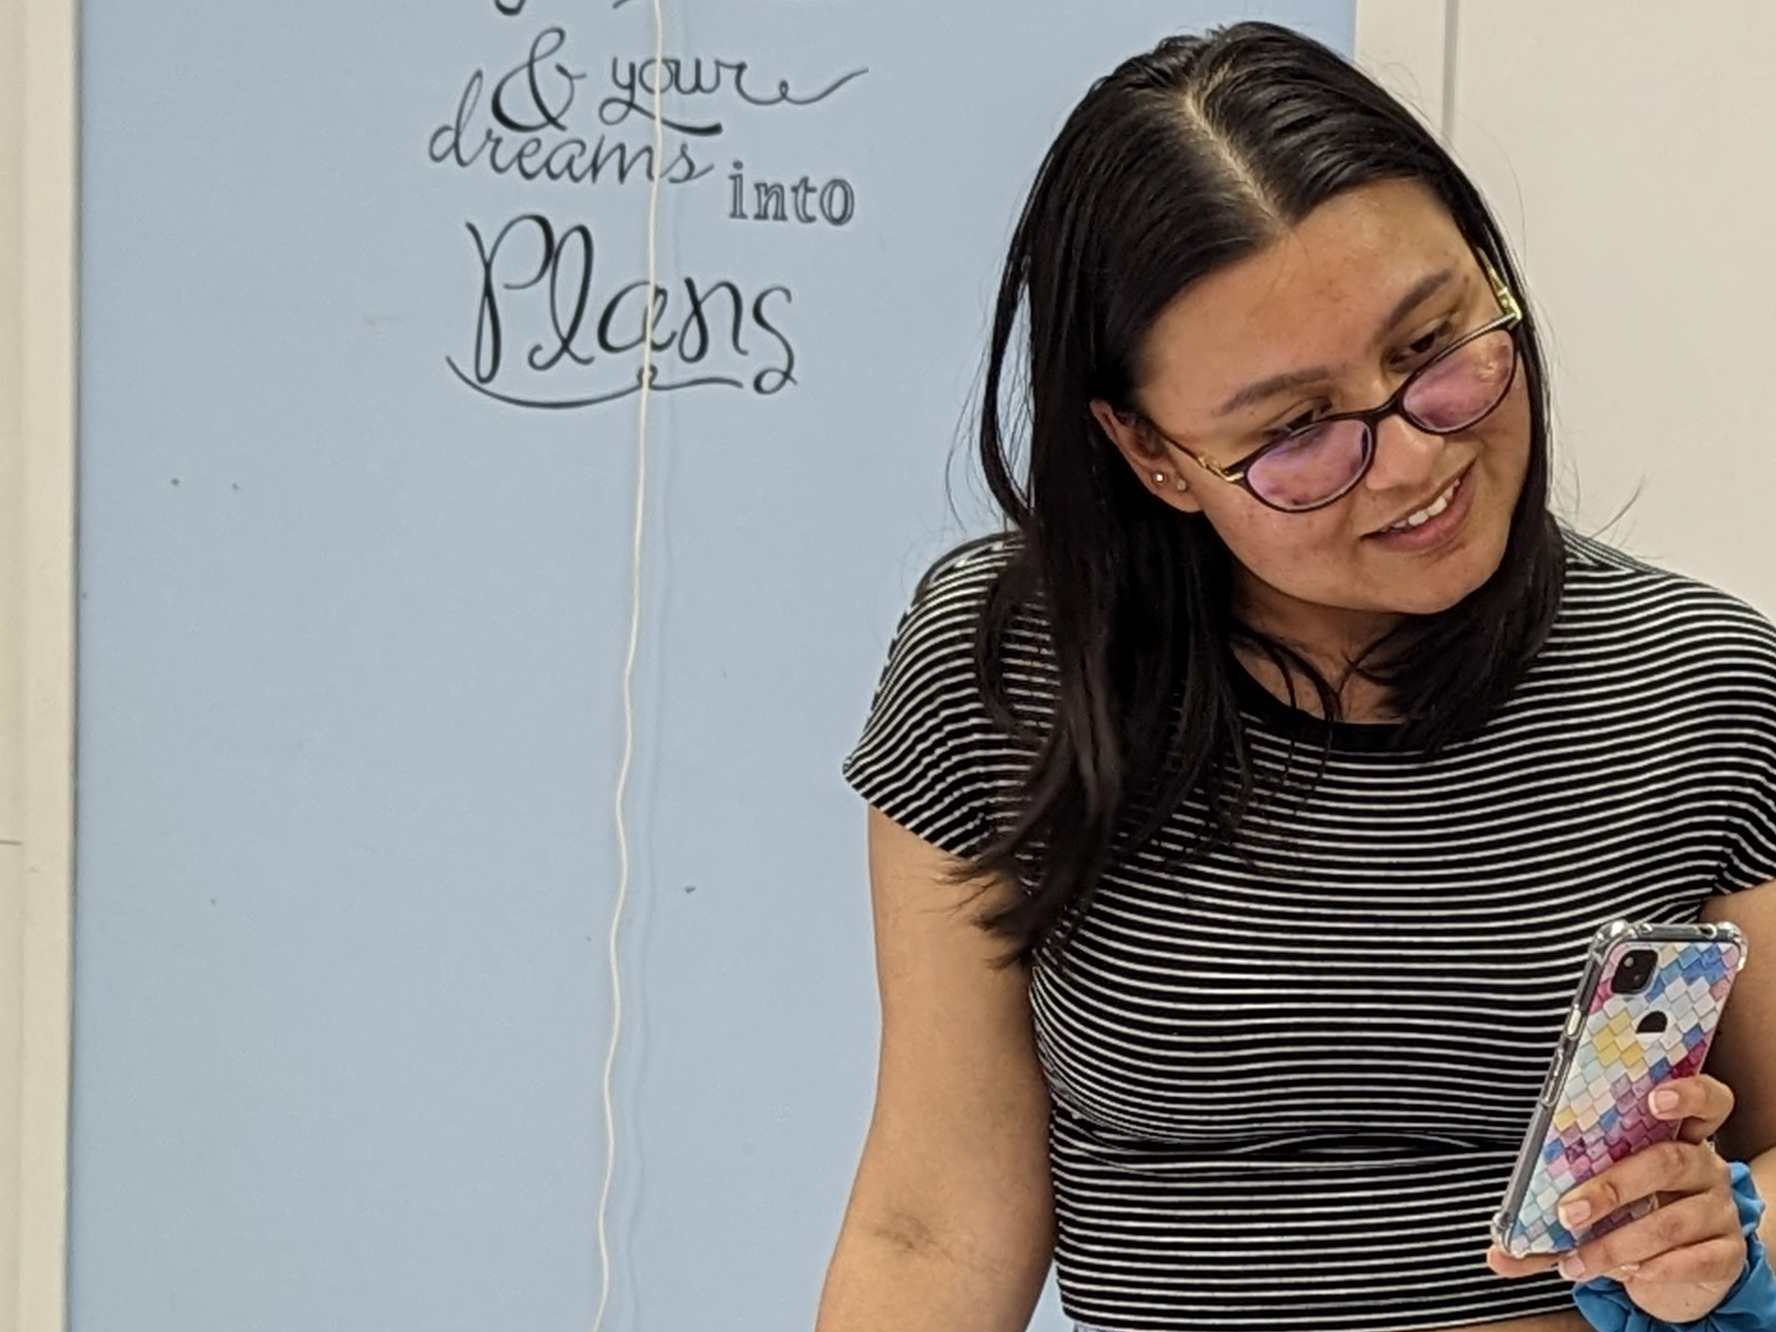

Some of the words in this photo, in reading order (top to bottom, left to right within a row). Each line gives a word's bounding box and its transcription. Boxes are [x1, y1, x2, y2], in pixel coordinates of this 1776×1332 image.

[428, 69, 714, 184] dreams
[728, 160, 856, 226] into
[491, 27, 587, 131] &
[455, 214, 799, 405] Plans
